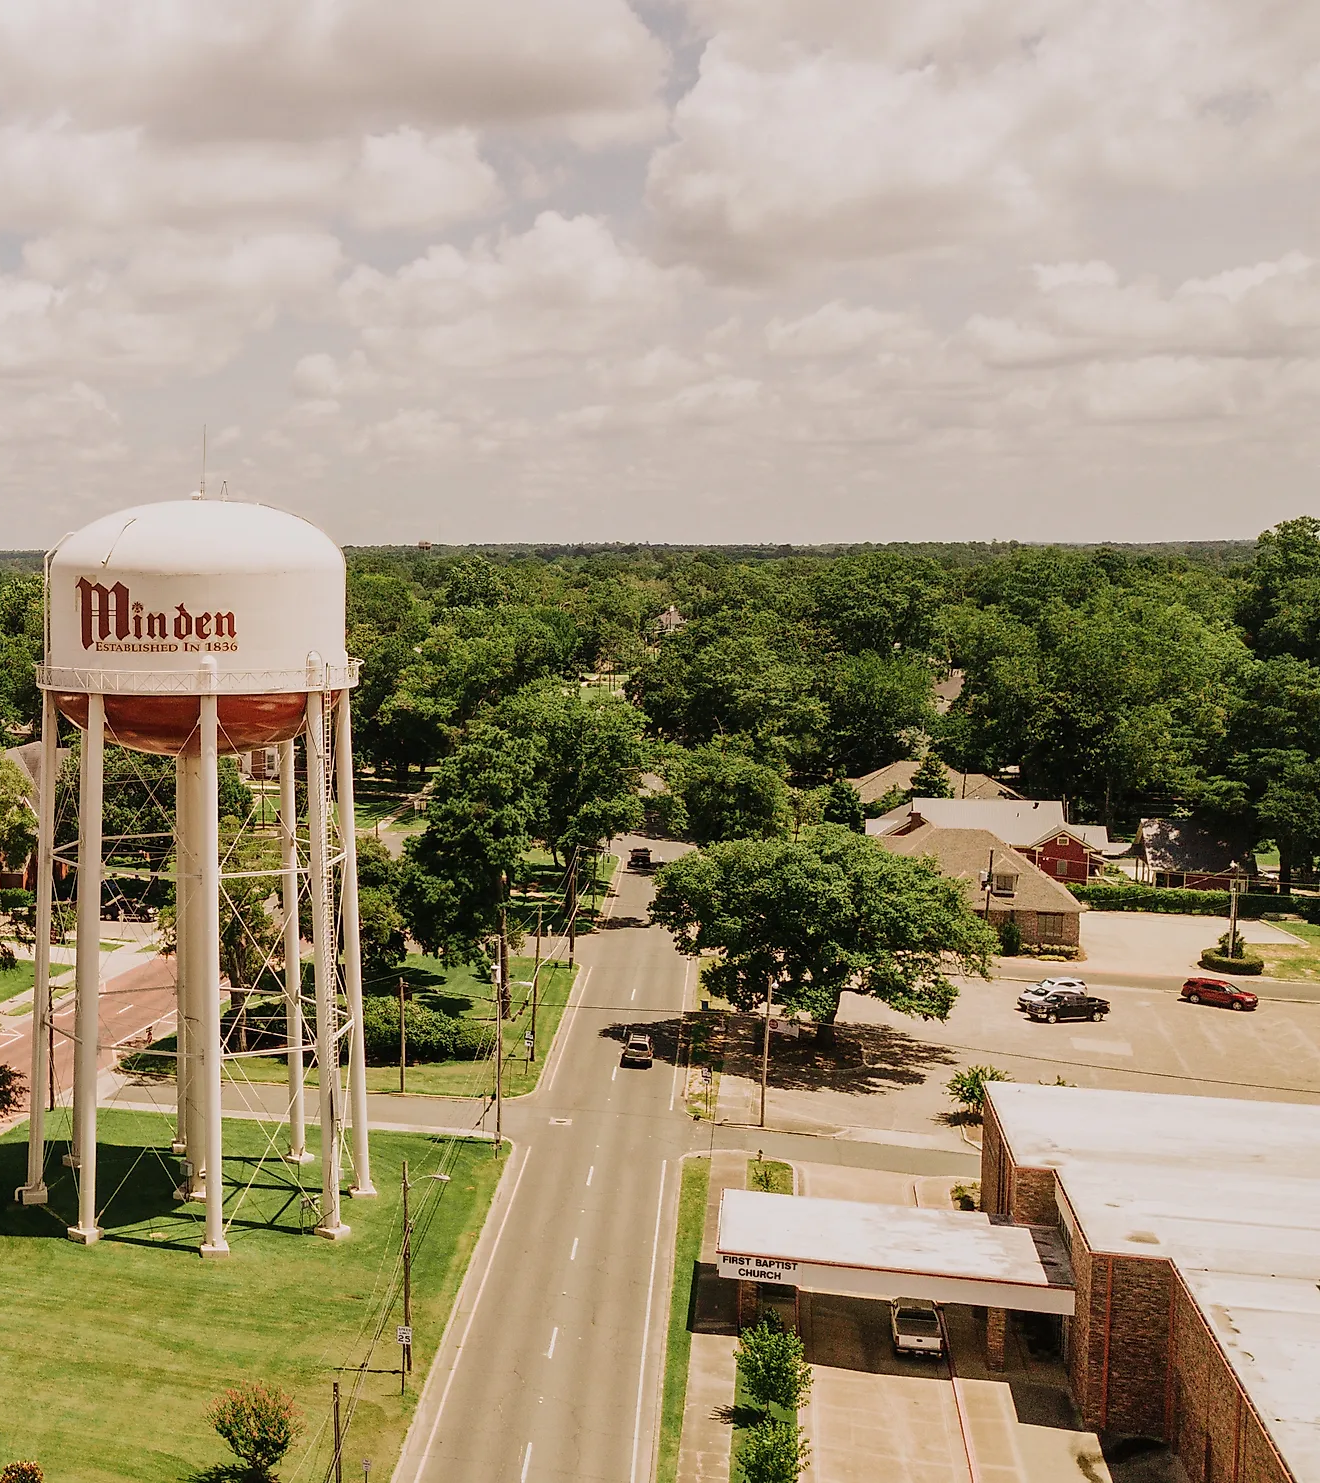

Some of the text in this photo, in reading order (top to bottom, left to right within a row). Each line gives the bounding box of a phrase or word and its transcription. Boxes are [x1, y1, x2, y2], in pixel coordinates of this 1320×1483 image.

[75, 576, 237, 650] Minden
[205, 642, 238, 652] 1836
[723, 1256, 798, 1270] FIRST BAPTIST
[738, 1268, 782, 1280] CHURCH
[398, 1335, 411, 1343] 25
